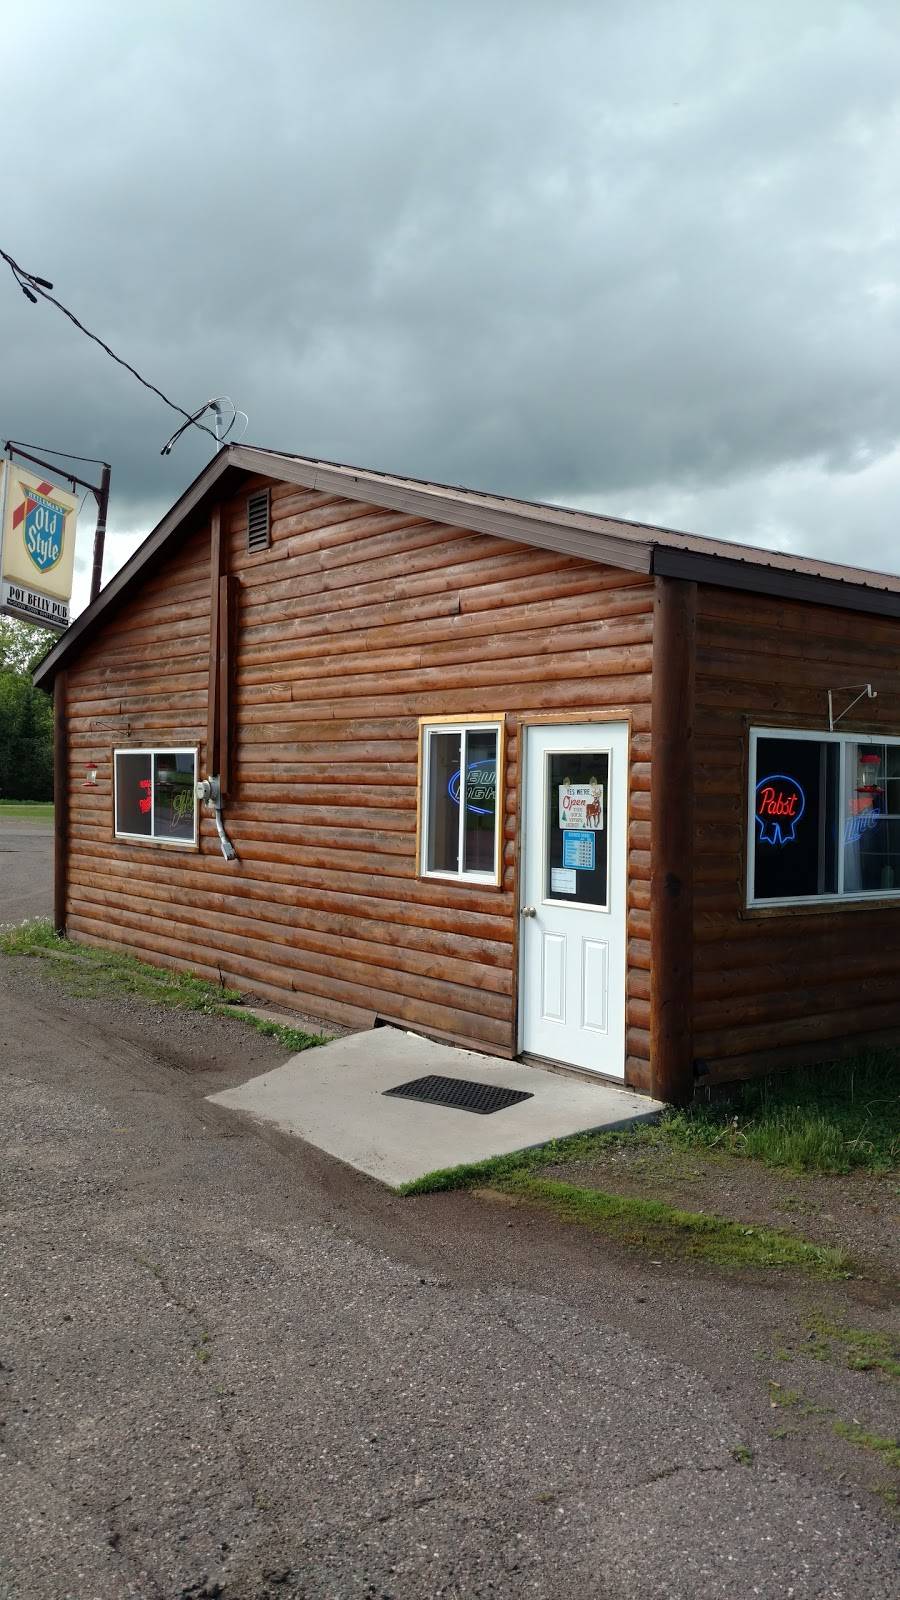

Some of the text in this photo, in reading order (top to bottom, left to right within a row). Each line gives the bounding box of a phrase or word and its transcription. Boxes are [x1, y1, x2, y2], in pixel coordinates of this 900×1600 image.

[35, 507, 57, 535] Old
[28, 525, 59, 565] Style
[9, 586, 25, 602] POT
[27, 592, 51, 612] BELLY
[52, 602, 68, 618] PUB
[466, 770, 497, 785] BU
[563, 795, 586, 811] Open
[759, 787, 798, 816] Pabst
